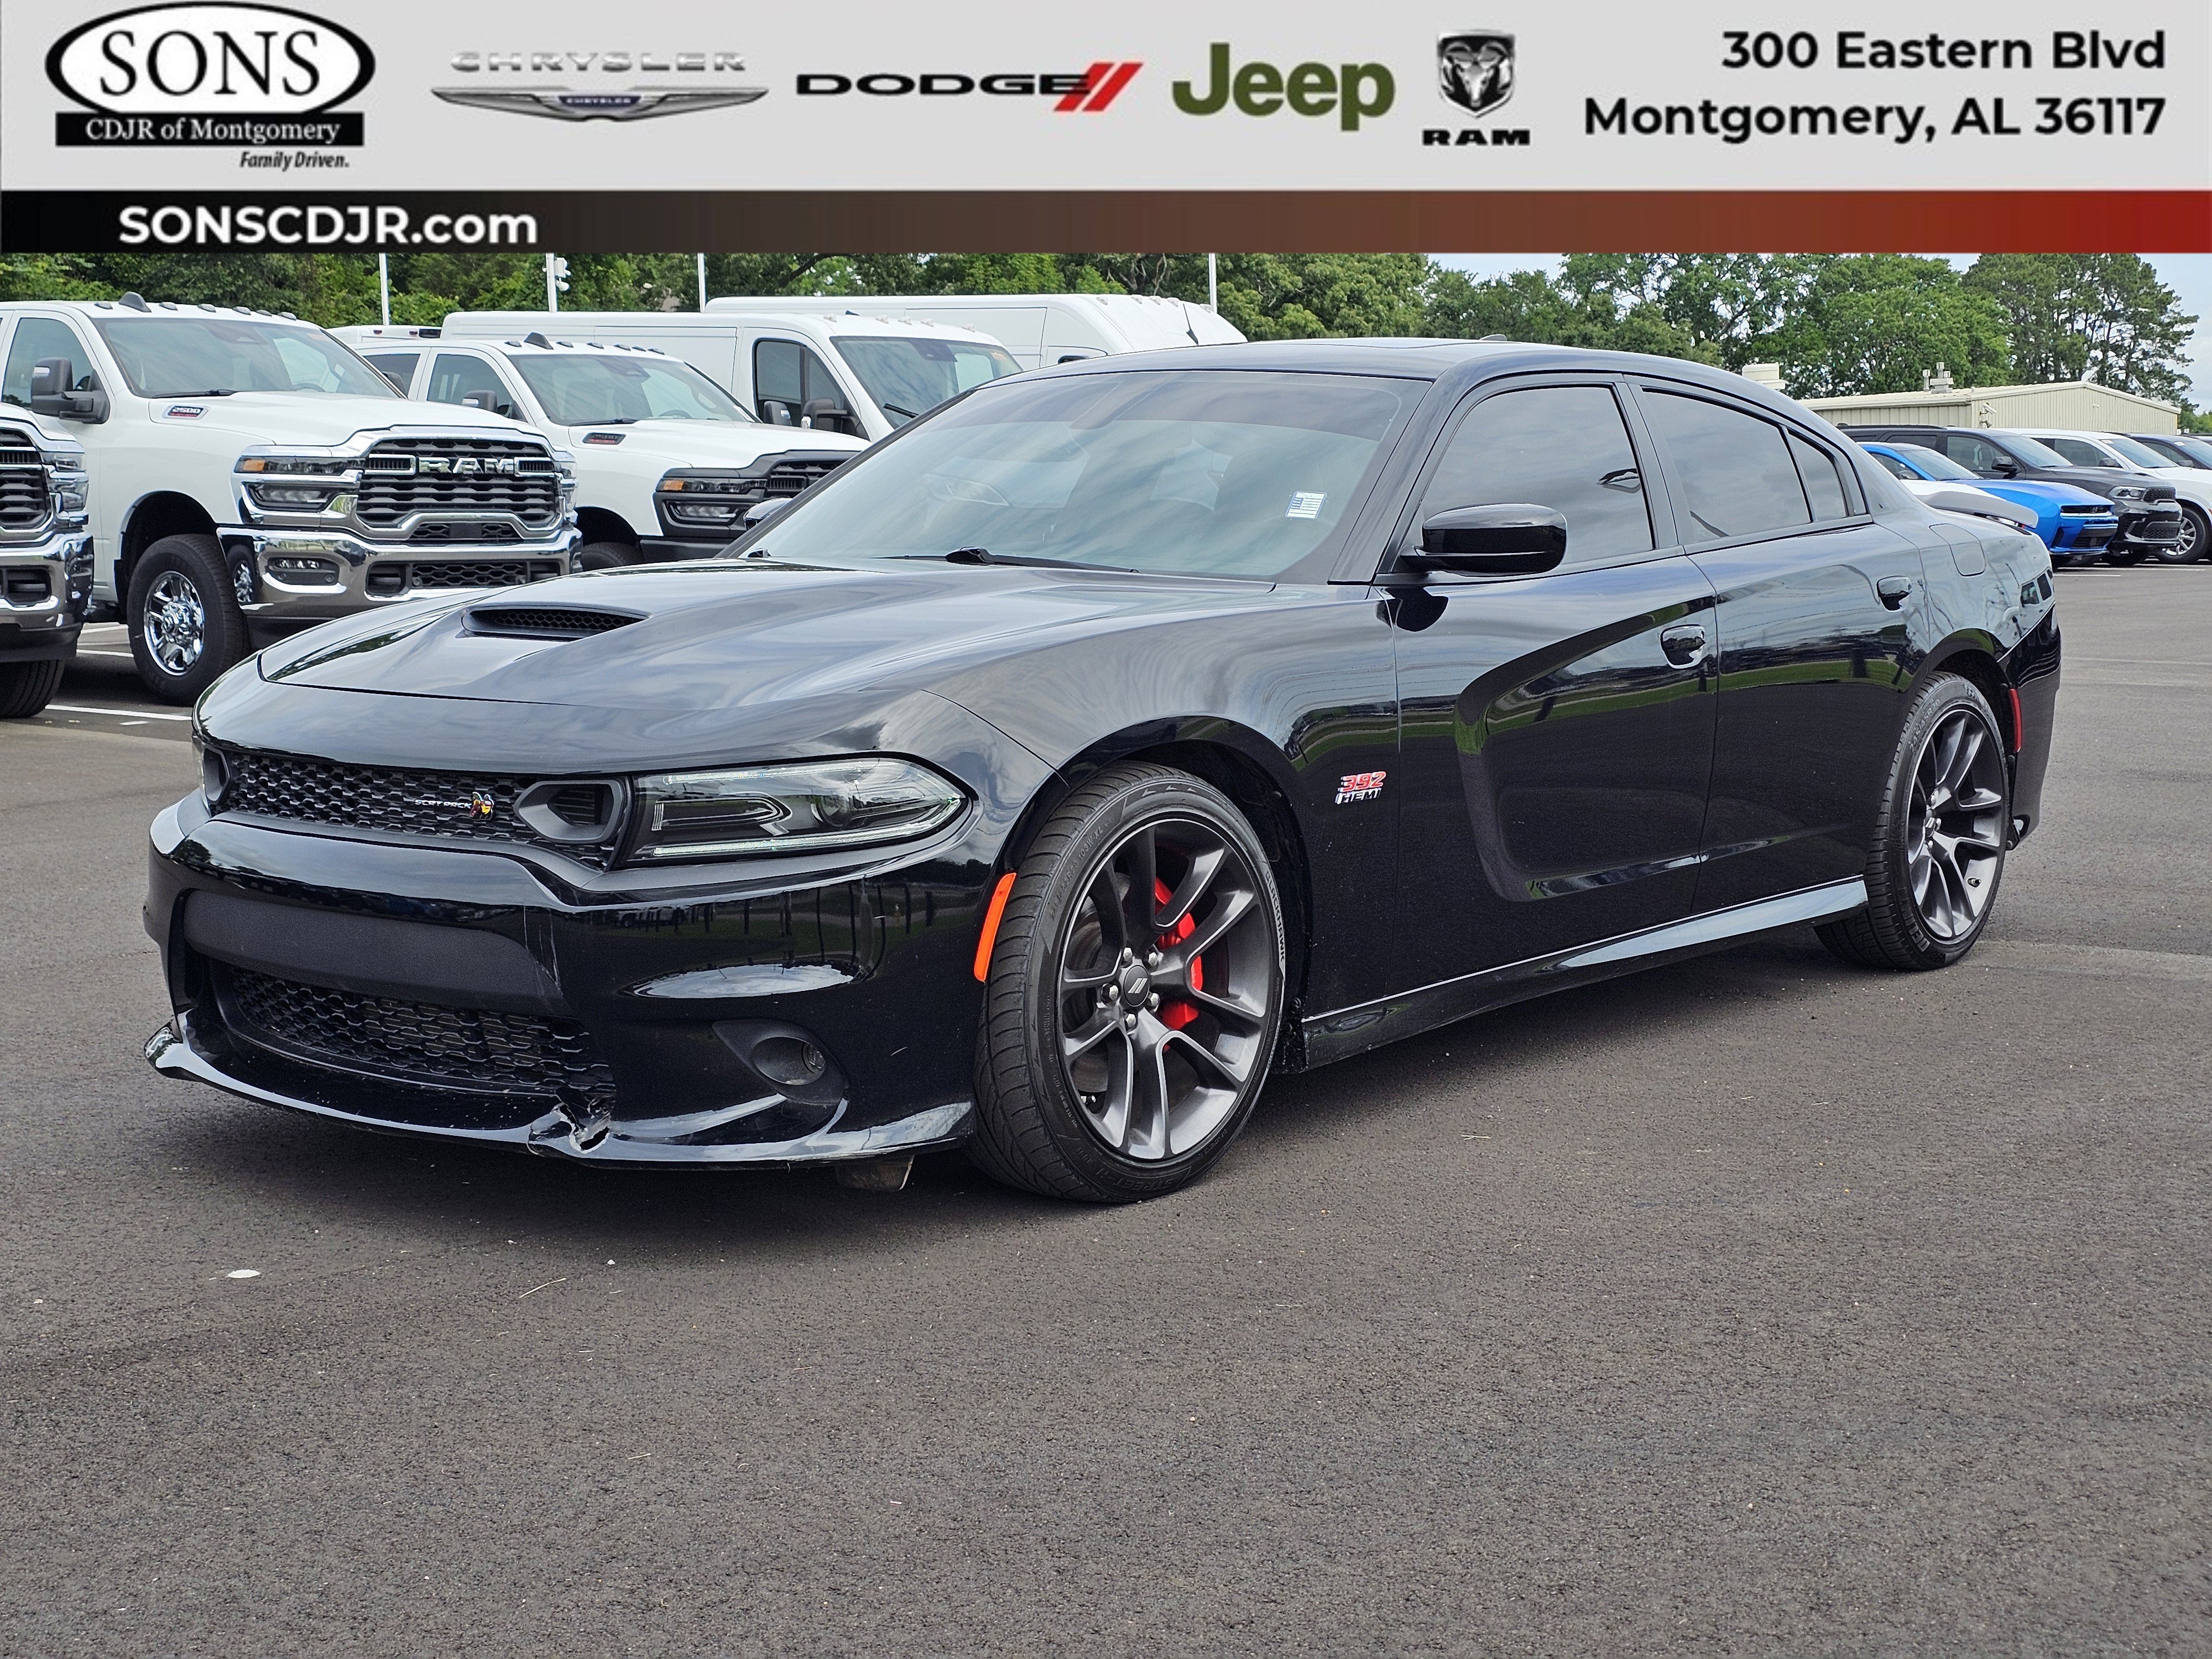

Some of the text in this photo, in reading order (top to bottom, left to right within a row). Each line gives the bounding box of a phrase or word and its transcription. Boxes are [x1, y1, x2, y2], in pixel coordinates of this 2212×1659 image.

[419, 457, 514, 474] RAM
[1338, 771, 1386, 792] 392
[1334, 787, 1382, 805] HEMI
[1265, 872, 1285, 962] BLACKHAWK
